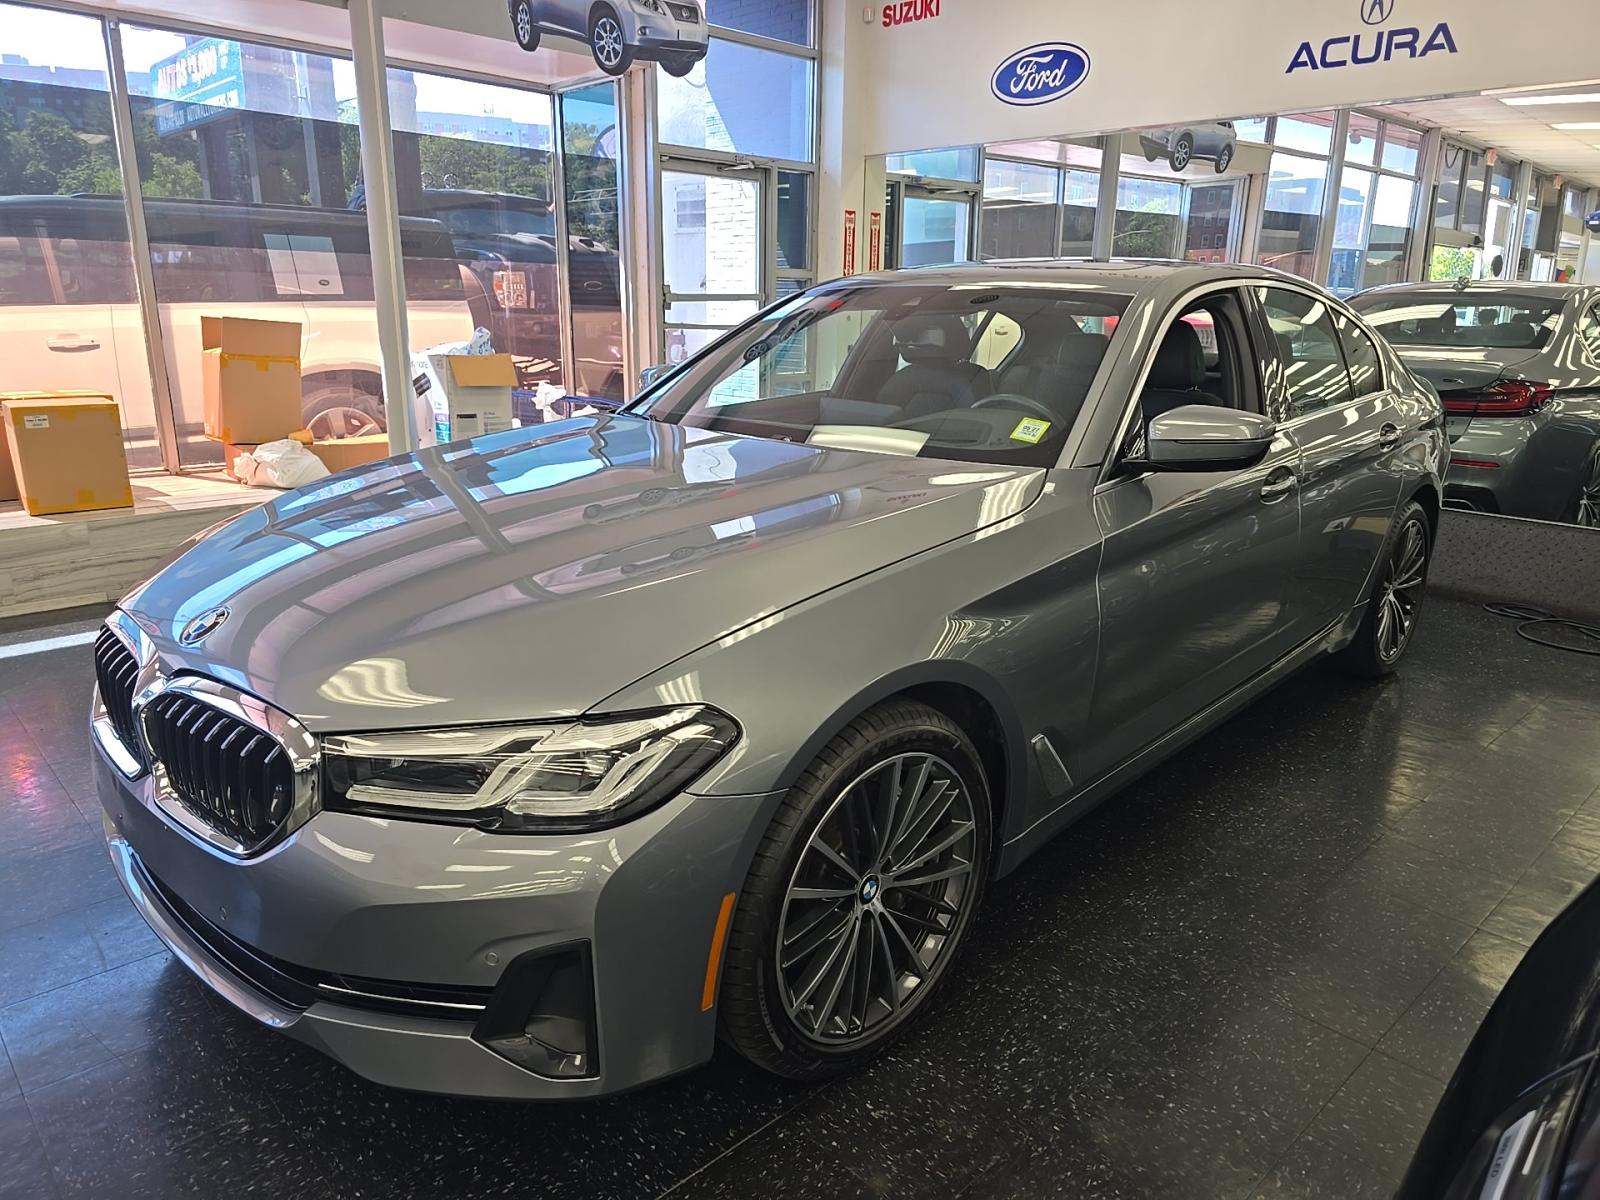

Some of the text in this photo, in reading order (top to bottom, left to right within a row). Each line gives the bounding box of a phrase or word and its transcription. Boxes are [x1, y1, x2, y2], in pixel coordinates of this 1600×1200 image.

[882, 0, 940, 27] SUZUKI
[1285, 22, 1458, 74] ACURA
[1010, 53, 1068, 94] Ford
